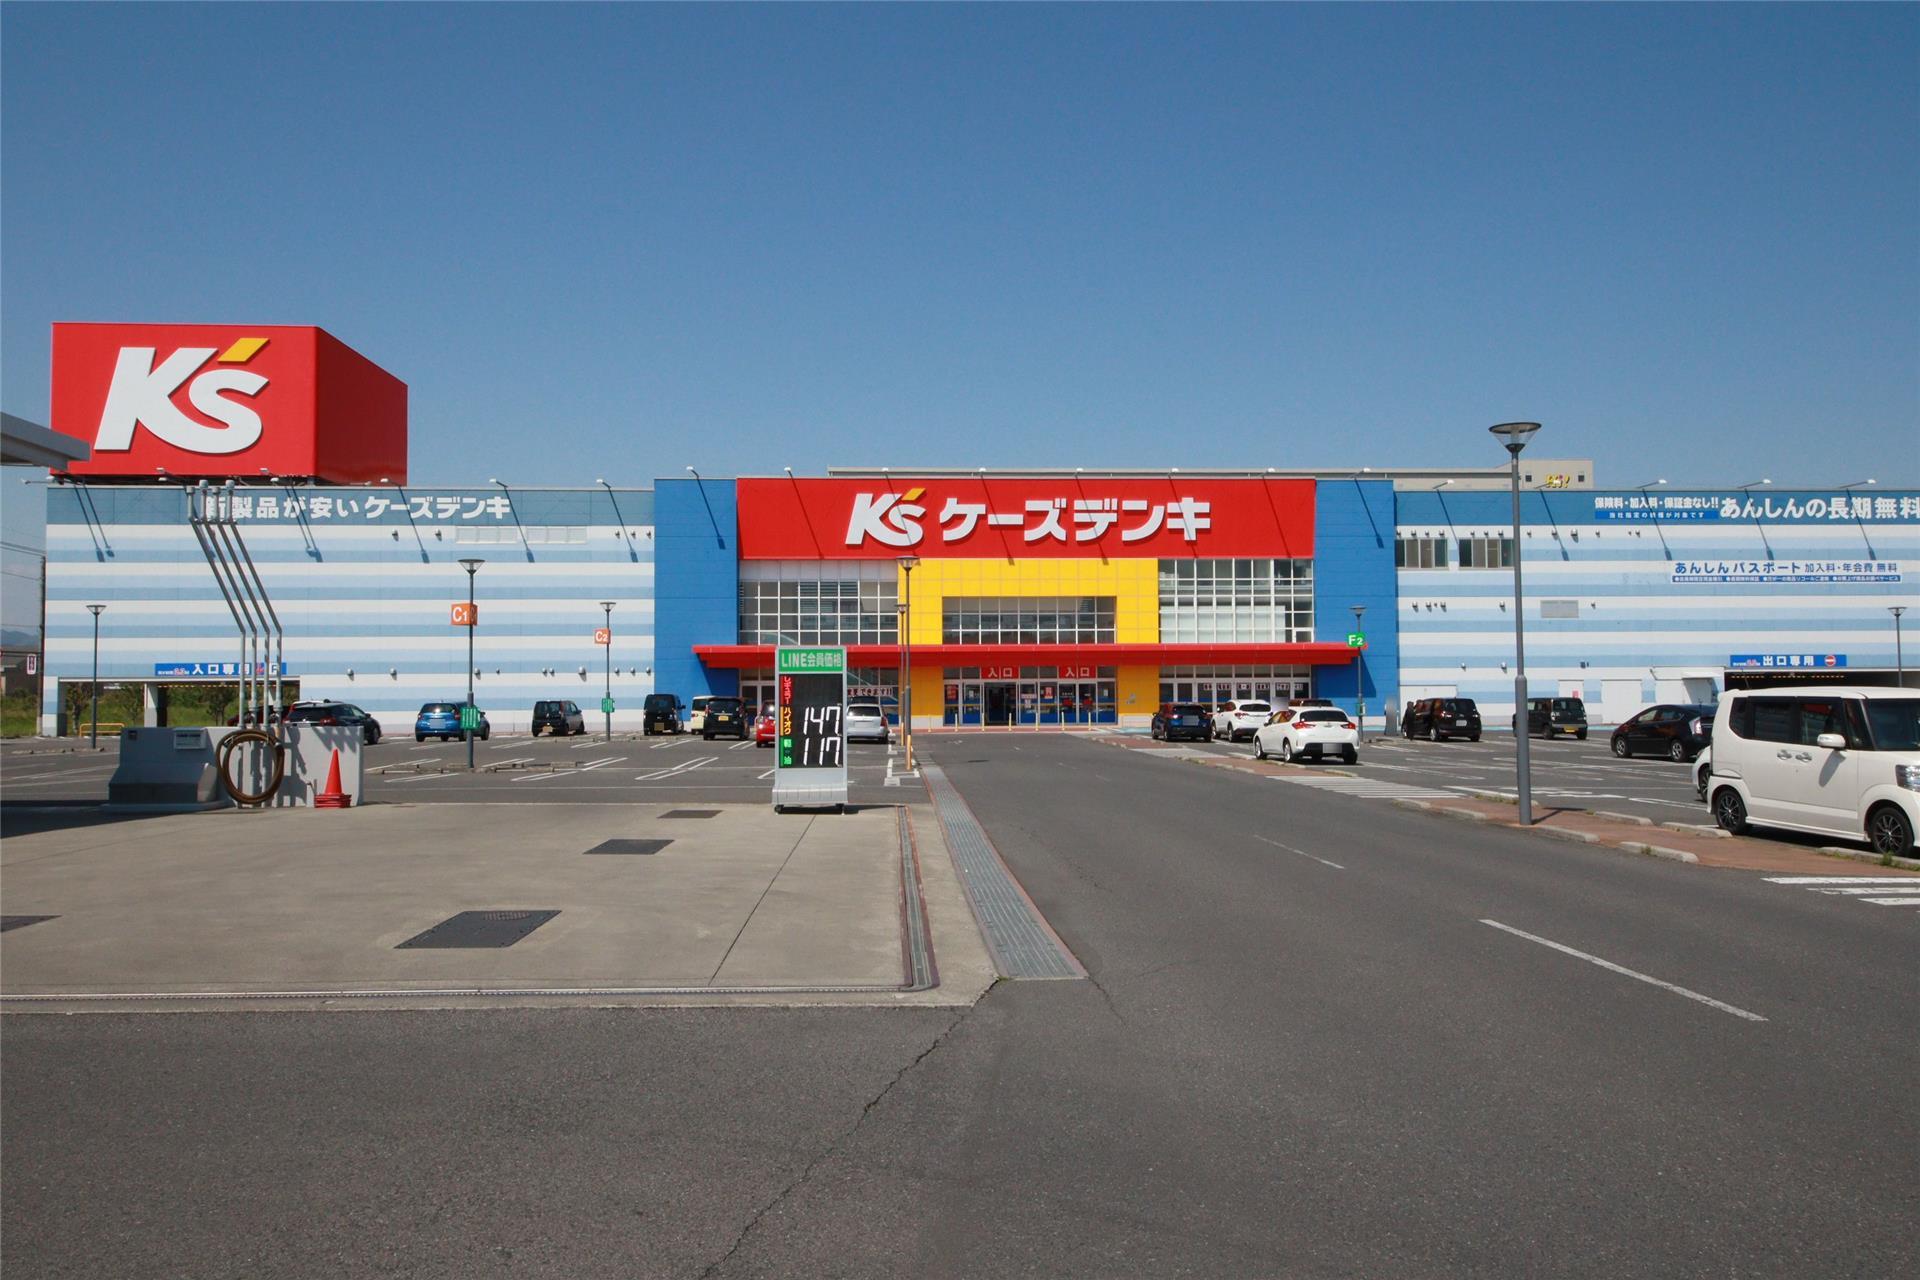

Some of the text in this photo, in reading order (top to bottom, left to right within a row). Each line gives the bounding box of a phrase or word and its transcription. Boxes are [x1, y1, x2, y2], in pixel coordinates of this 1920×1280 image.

[93, 337, 270, 454] K's
[845, 488, 1211, 546] K's ケーズデンキ
[1675, 562, 1800, 574] あんしんパスポート
[1877, 562, 1897, 573] 無料
[453, 606, 468, 622] C1
[595, 631, 608, 642] C2
[1348, 635, 1364, 645] F2
[781, 652, 842, 668] LINE会員価格
[1763, 655, 1814, 666] 出口専用
[988, 667, 1013, 678] 入口
[1065, 667, 1090, 678] 入口
[784, 707, 792, 735] ハイオク
[803, 706, 842, 736] 147
[803, 737, 842, 767] 117
